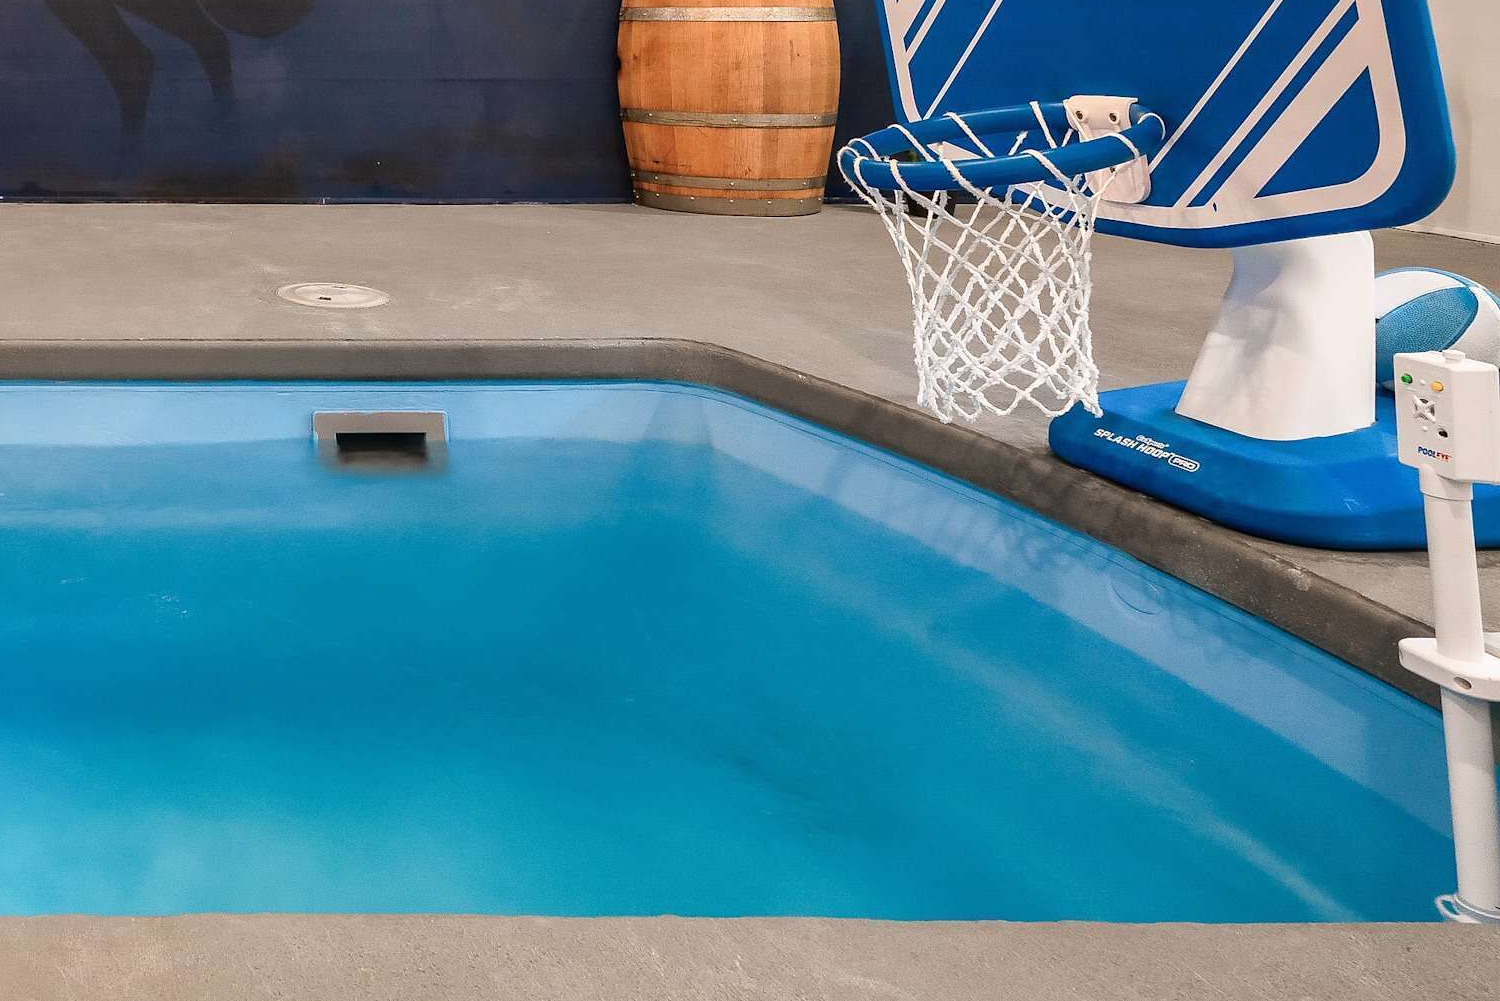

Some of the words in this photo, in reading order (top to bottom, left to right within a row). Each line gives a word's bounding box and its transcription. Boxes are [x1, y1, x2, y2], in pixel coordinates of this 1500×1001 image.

[1094, 428, 1138, 449] SPLASH
[1137, 443, 1171, 459] HOOP
[1173, 457, 1197, 470] PRO
